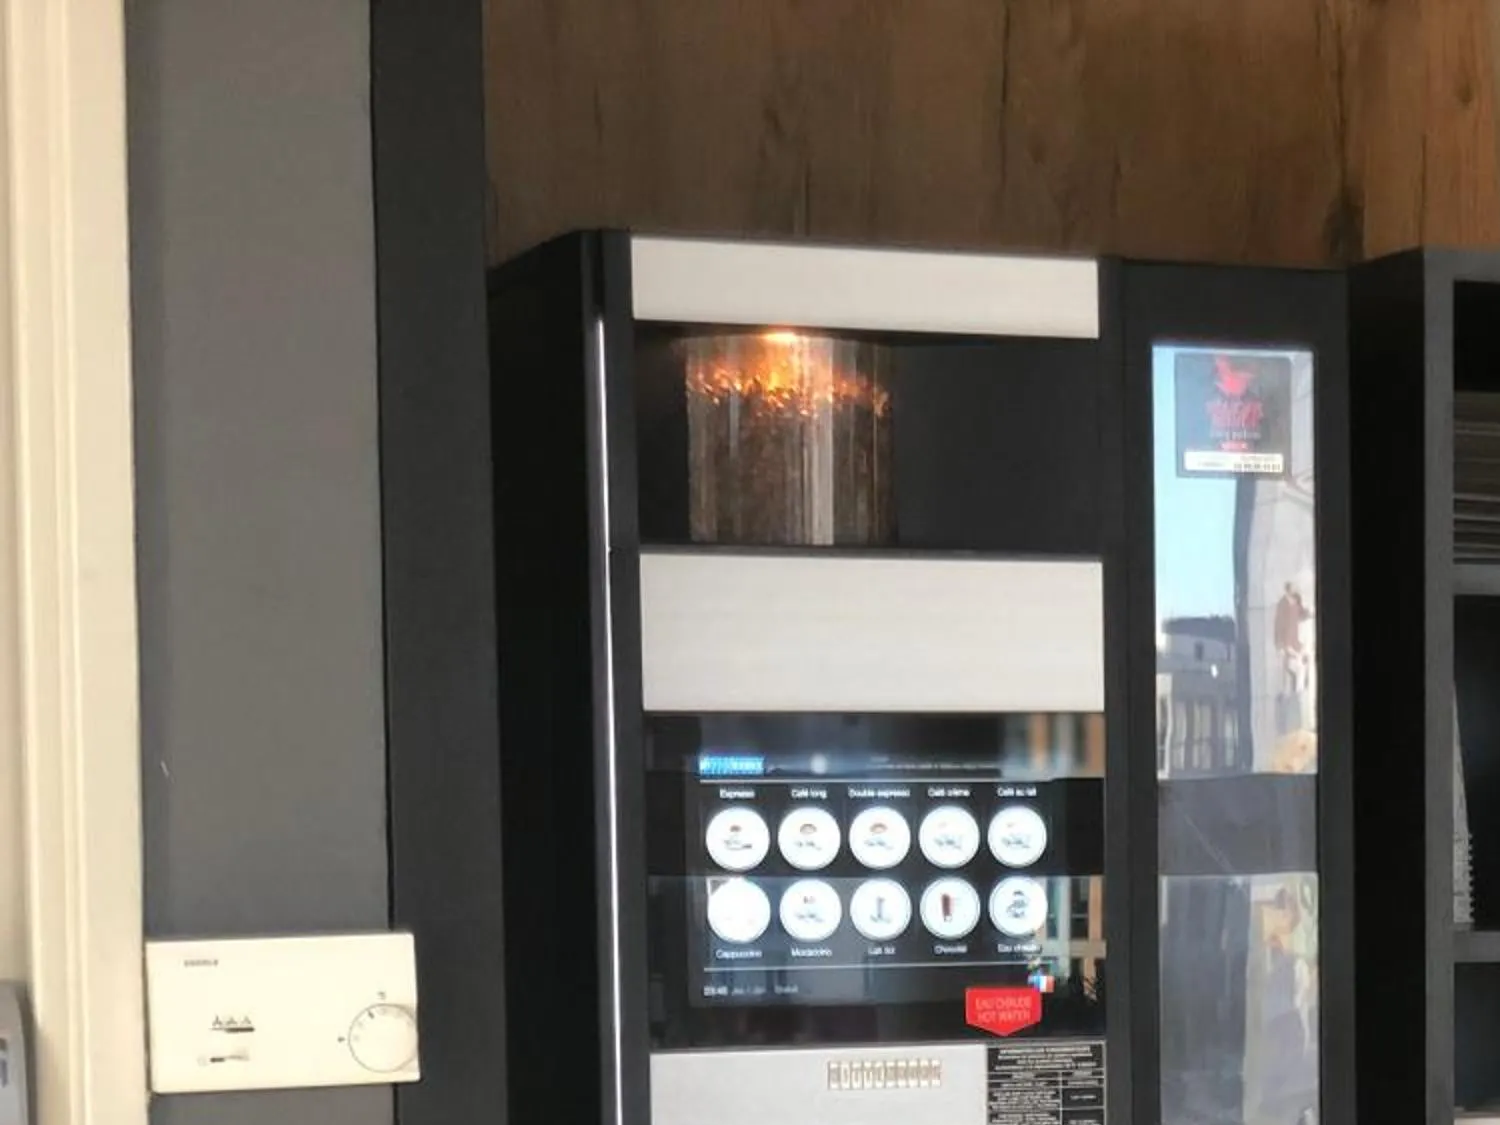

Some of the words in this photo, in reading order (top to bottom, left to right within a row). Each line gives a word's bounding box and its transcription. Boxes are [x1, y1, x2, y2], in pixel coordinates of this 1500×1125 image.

[848, 787, 875, 798] Double
[997, 943, 1012, 953] Eau
[995, 995, 1032, 1009] CHAUDE
[977, 1010, 996, 1023] HOT
[998, 1008, 1031, 1022] WATER
